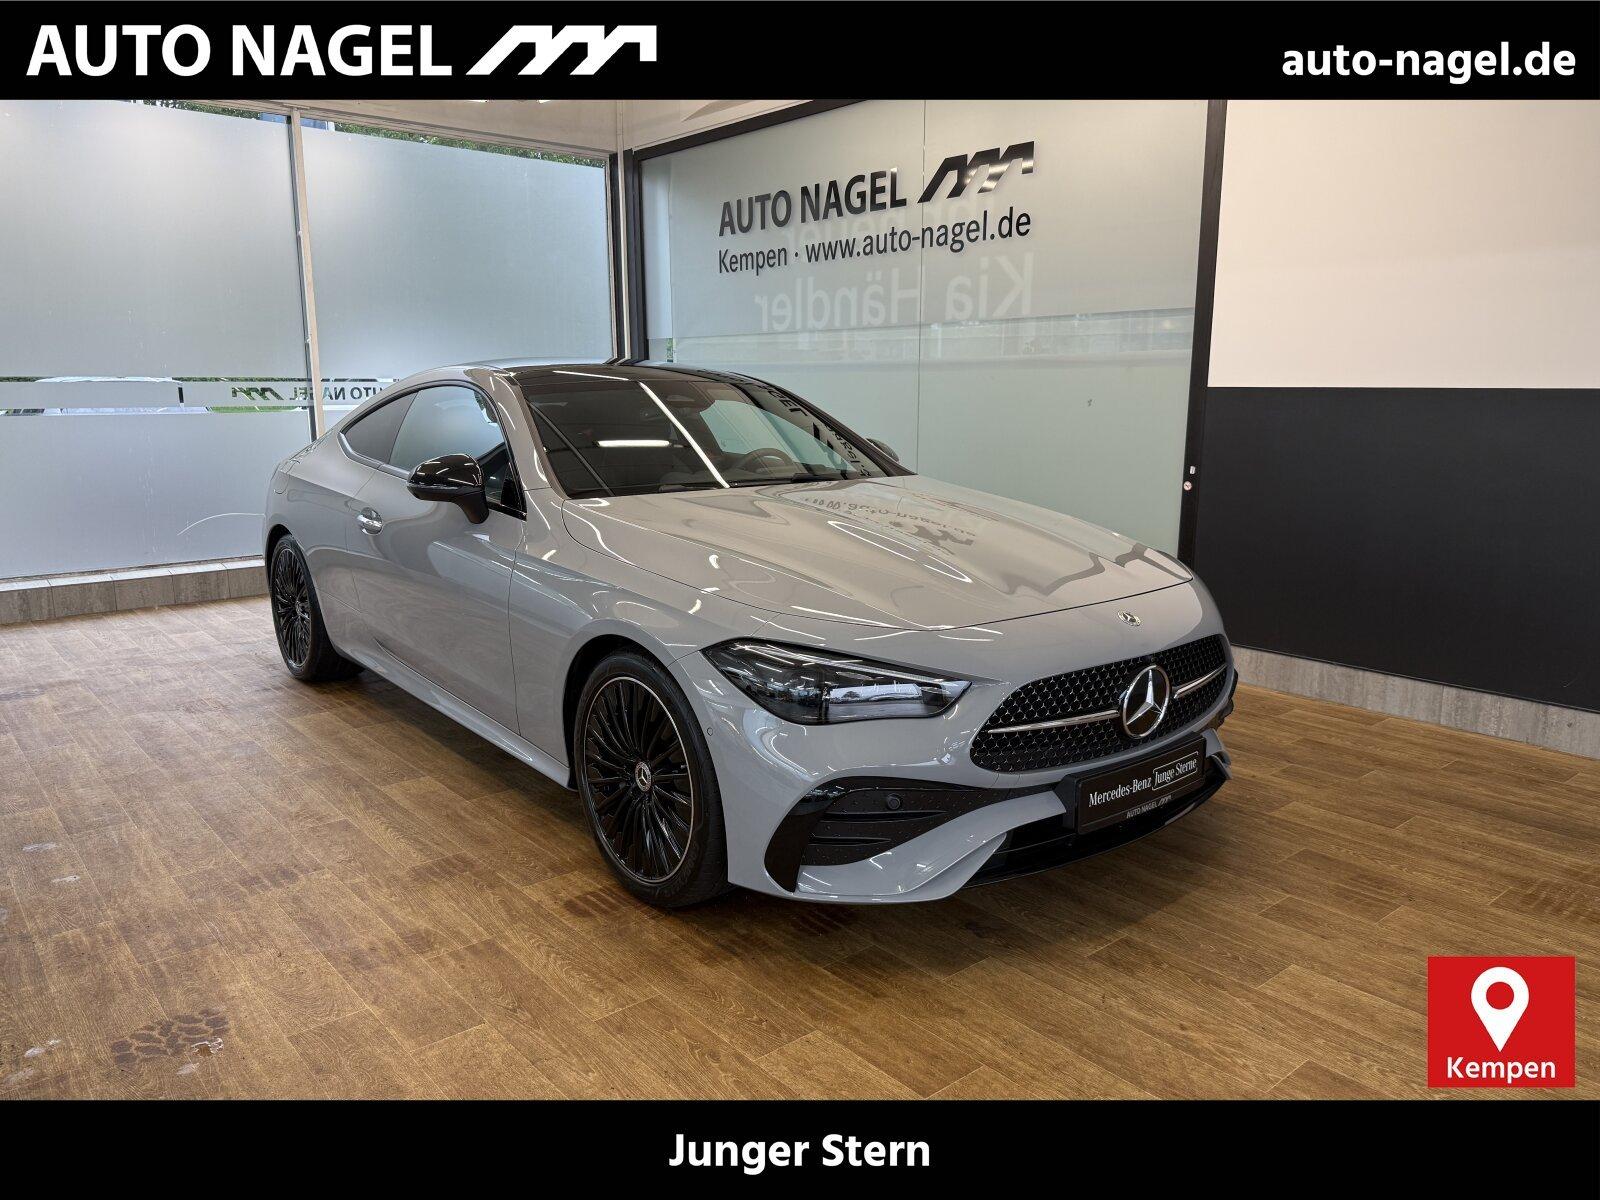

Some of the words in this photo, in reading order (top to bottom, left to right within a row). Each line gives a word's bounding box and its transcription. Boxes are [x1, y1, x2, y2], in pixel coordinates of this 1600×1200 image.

[718, 189, 793, 237] AUTO
[800, 166, 907, 224] NAGEL
[718, 246, 788, 276] Kempen
[805, 206, 1031, 265] www.auto-nagel.de
[1088, 777, 1152, 807] Mercedes-Benz
[1154, 768, 1175, 786] Junge
[1175, 758, 1197, 776] Sterne
[1126, 809, 1141, 819] AUTO
[1141, 802, 1158, 813] NAGEL
